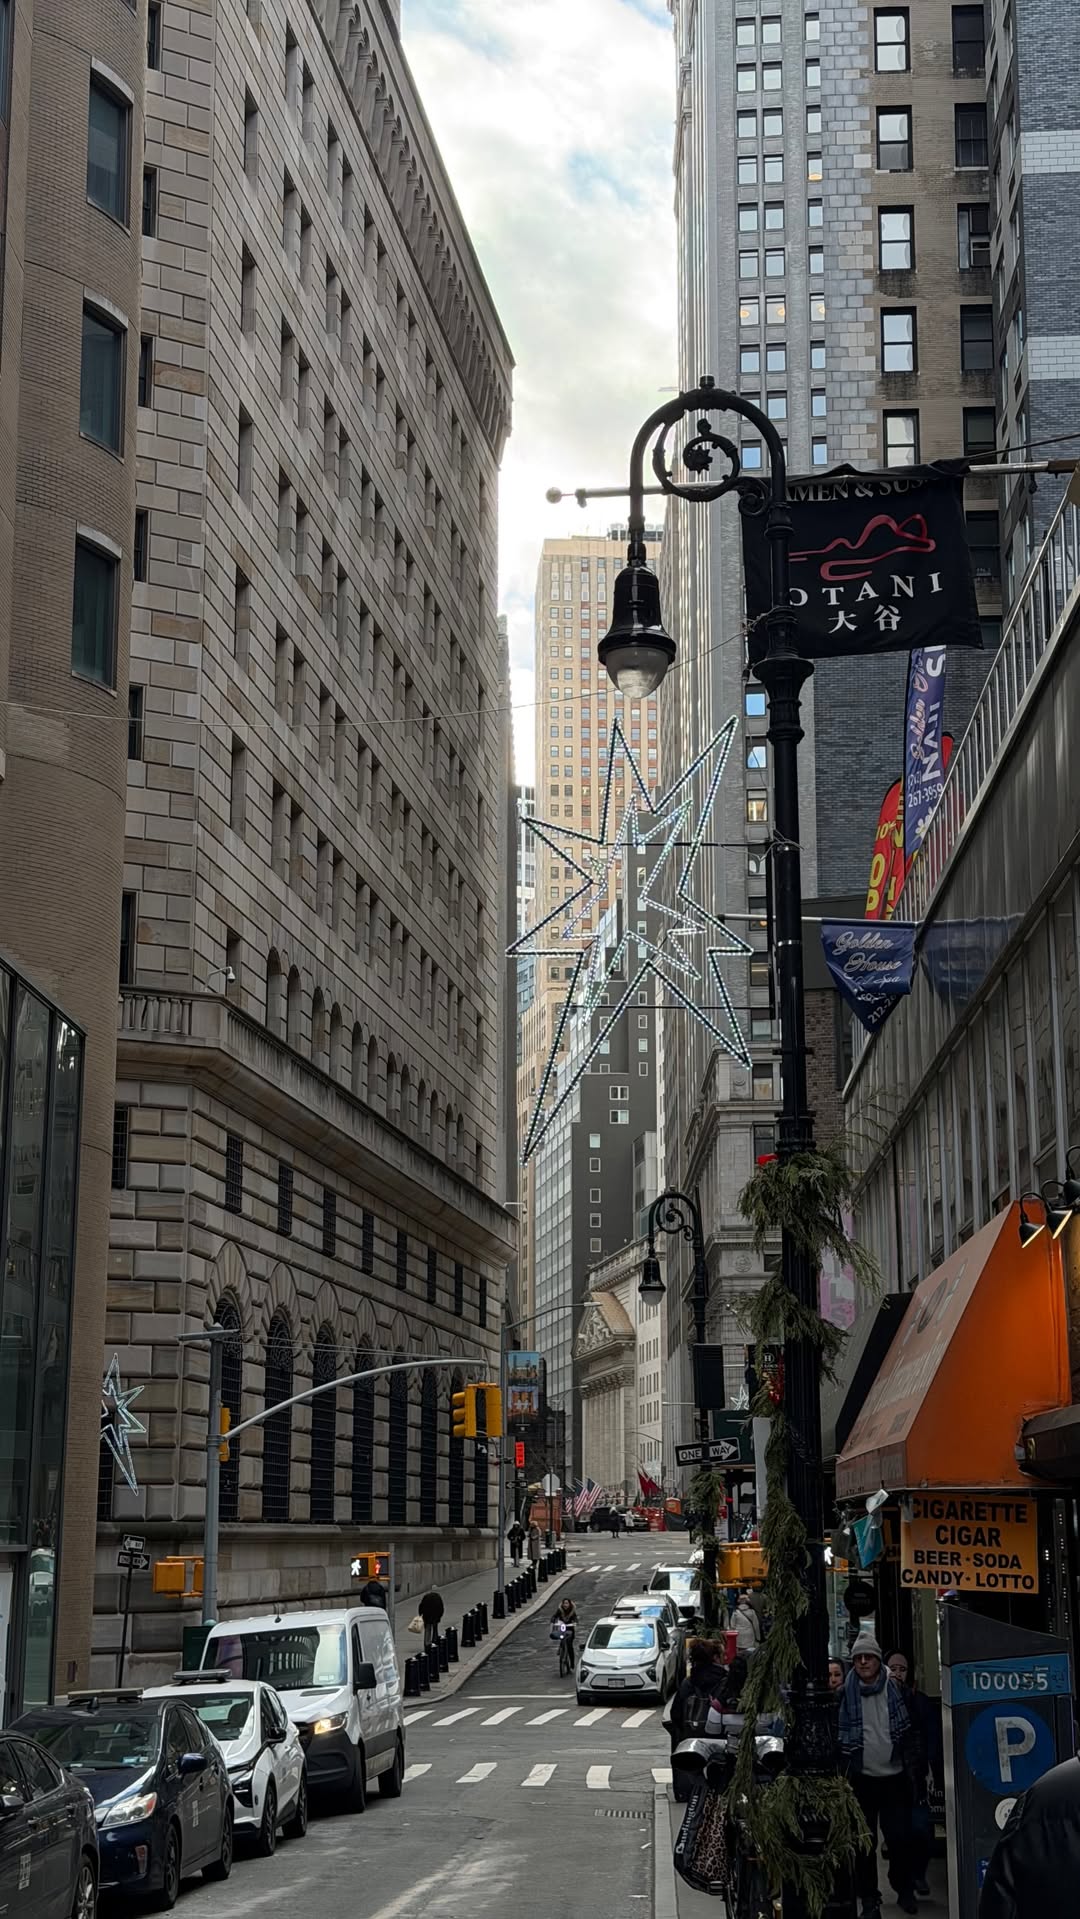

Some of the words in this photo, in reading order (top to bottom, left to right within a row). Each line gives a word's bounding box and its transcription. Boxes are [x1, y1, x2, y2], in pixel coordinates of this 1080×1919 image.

[784, 479, 850, 502] AMEN
[854, 482, 875, 499] &
[788, 571, 944, 607] OTANI
[827, 604, 903, 634] 大谷
[907, 782, 943, 808] 267-3959
[831, 931, 895, 956] Golden
[843, 951, 903, 973] House
[680, 1449, 701, 1461] ONE
[711, 1445, 732, 1457] WAY
[912, 1498, 1028, 1524] CIGARETTE
[935, 1525, 1001, 1548] CIGAR
[914, 1549, 962, 1567] BEER
[972, 1552, 1022, 1570] SODA
[902, 1568, 964, 1586] CANDY
[975, 1572, 1035, 1590] LOTTO
[994, 1716, 1037, 1783] P
[675, 1794, 699, 1855] Burlington
